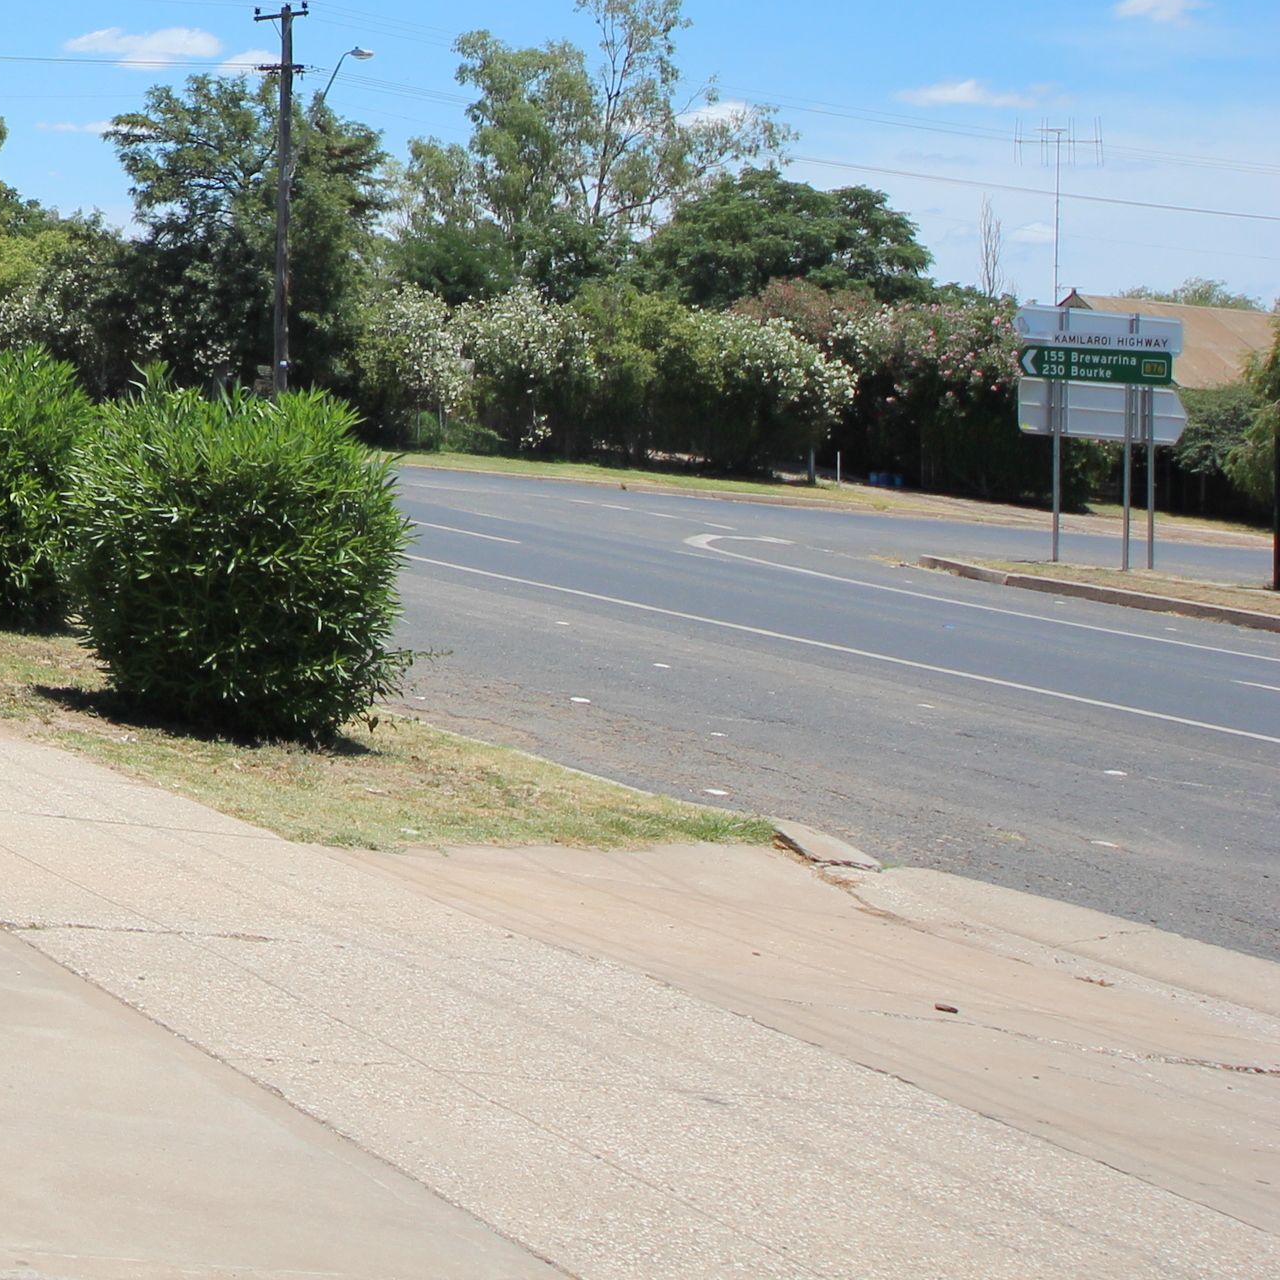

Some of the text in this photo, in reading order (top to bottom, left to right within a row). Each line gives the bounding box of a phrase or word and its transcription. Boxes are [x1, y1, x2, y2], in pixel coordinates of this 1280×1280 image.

[1054, 335, 1168, 348] KAMILAROI HIGHWAY
[1043, 351, 1137, 366] 155 Brewarrina
[1042, 365, 1112, 378] 230 Bourke
